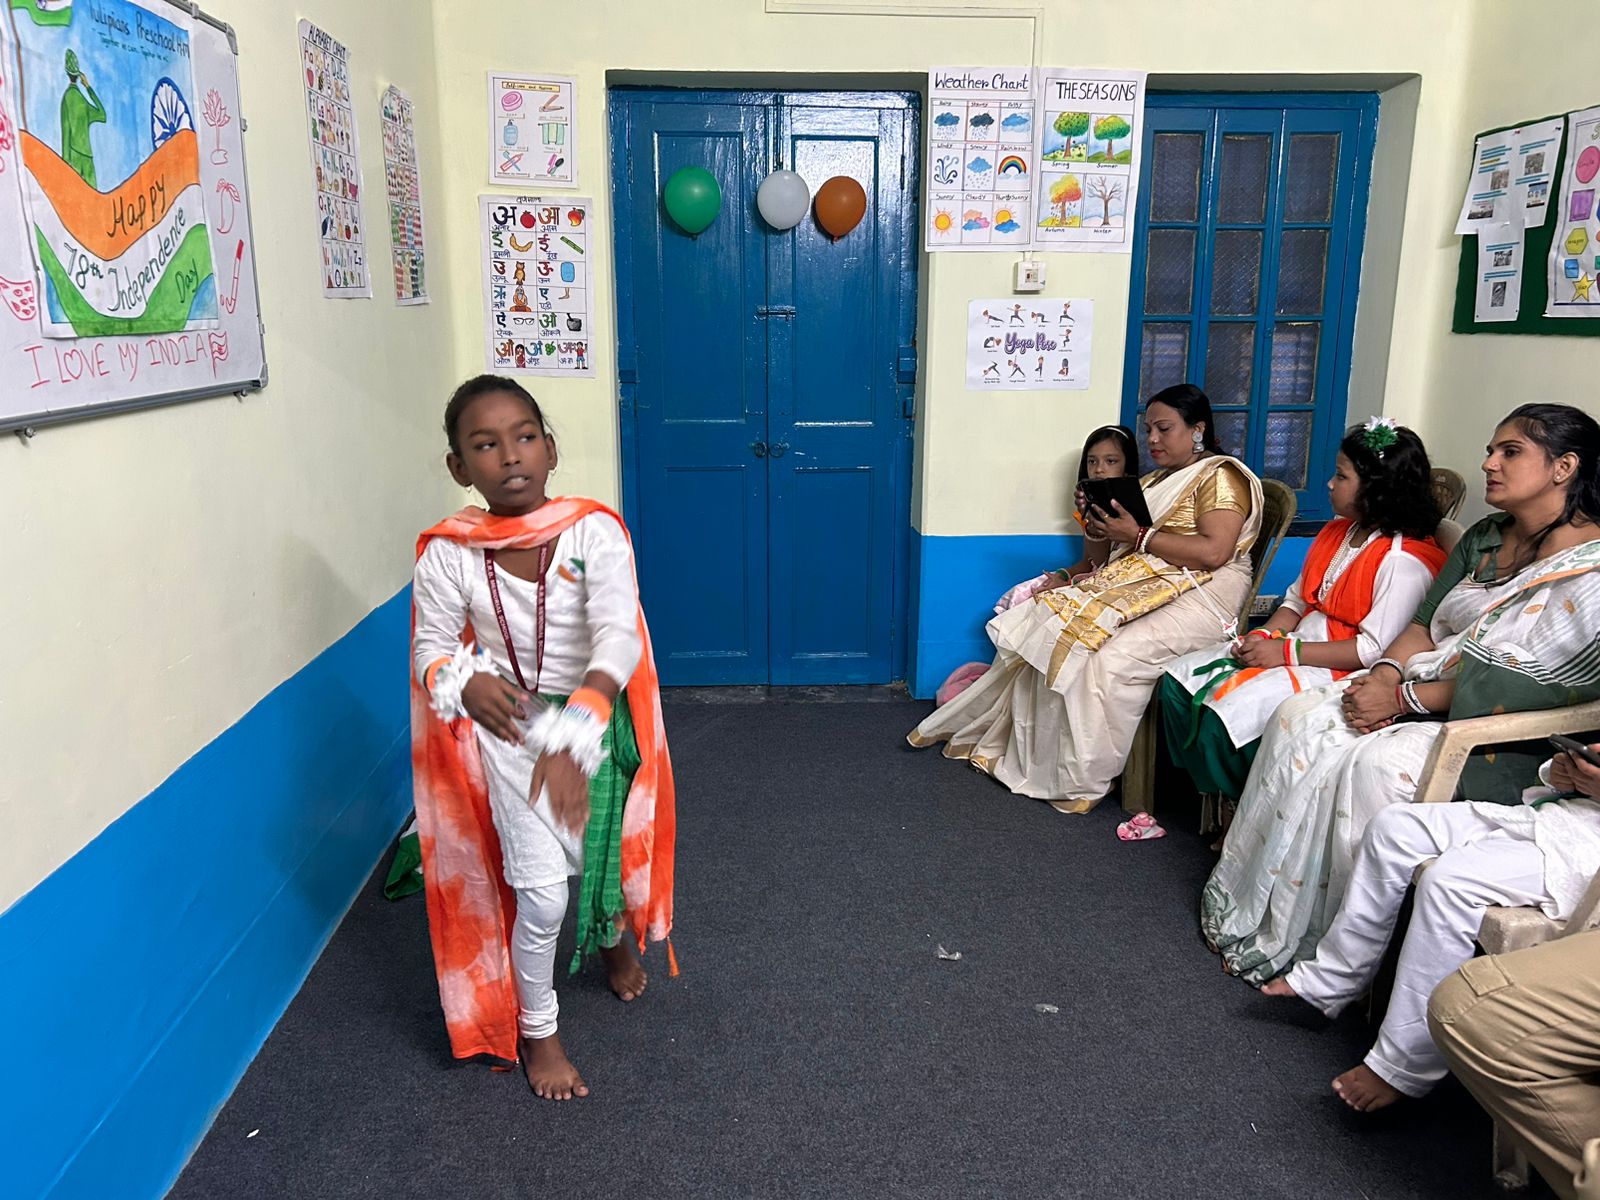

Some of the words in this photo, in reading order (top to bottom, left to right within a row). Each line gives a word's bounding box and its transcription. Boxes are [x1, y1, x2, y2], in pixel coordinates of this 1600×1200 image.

[136, 10, 176, 52] Preschool
[935, 72, 989, 89] Weather
[992, 73, 1029, 89] Chart
[107, 173, 165, 238] Happy
[493, 206, 517, 225] अ
[538, 207, 560, 225] आ
[538, 233, 550, 252] ई
[108, 207, 186, 311] Independence
[493, 260, 506, 275] उ
[537, 261, 554, 276] ऊ
[175, 259, 198, 303] Day
[538, 288, 549, 300] ए
[496, 312, 506, 328] ऐ
[1004, 332, 1035, 354] Yoga
[1036, 331, 1057, 351] Pose
[24, 346, 50, 388] I
[54, 343, 110, 384] LOVE
[118, 343, 139, 382] MY
[146, 333, 207, 366] INDIA
[490, 579, 502, 614] MEMORIAL
[499, 614, 509, 640] SCHOOL
